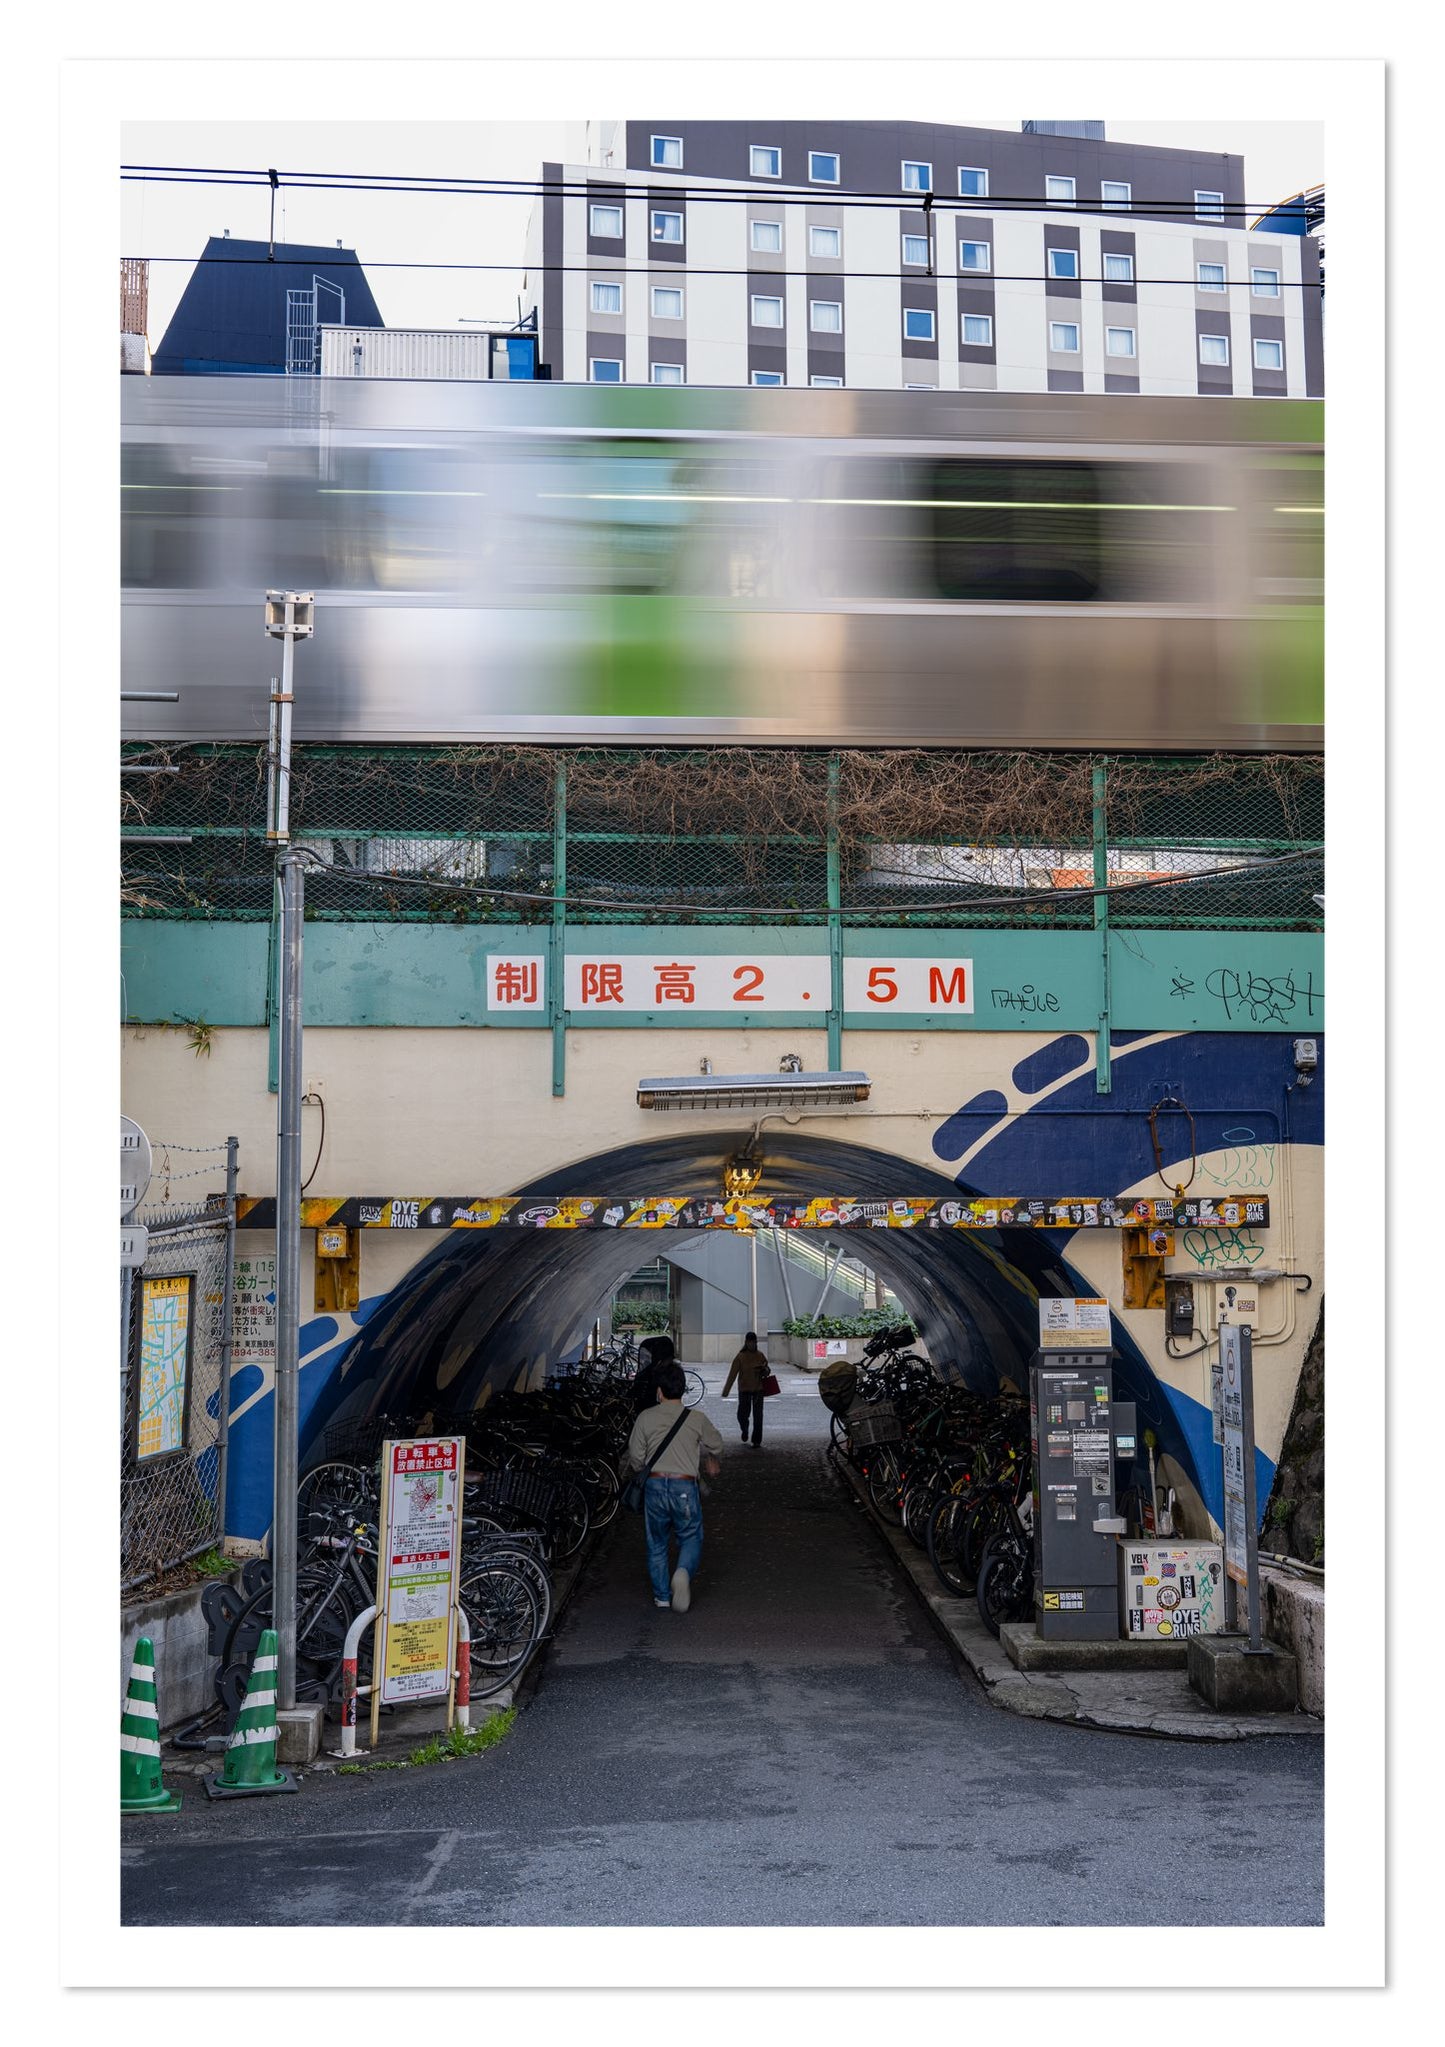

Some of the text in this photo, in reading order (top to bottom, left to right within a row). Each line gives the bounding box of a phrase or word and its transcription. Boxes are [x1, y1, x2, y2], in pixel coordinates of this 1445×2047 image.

[392, 1201, 419, 1215] OYE
[1246, 1203, 1264, 1212] OYE
[390, 1214, 418, 1228] RUNS
[1246, 1212, 1264, 1221] RUNS
[1172, 1609, 1200, 1624] OYE
[1173, 1623, 1200, 1638] RUNS
